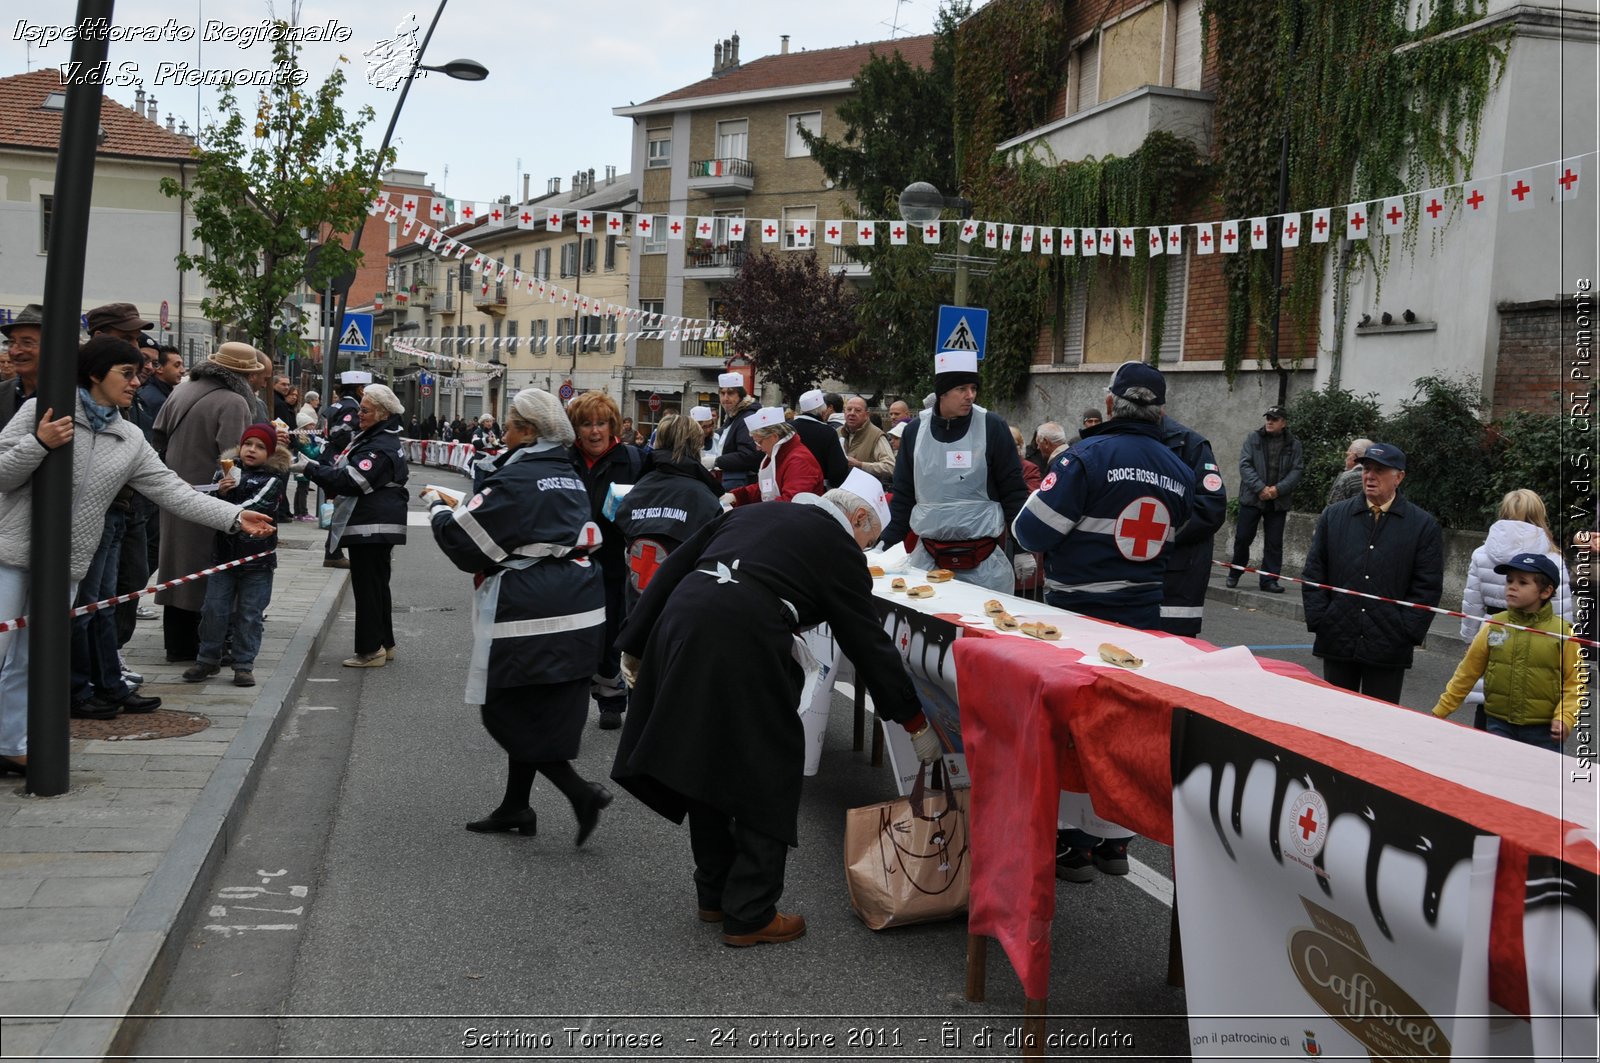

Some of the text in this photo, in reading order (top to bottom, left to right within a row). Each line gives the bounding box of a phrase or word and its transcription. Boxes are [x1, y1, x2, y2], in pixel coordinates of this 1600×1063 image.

[536, 477, 561, 491] CROCE
[1107, 467, 1186, 497] CROCE ROSSA ITALIAN
[631, 507, 687, 523] CROCE ROSSA ITALIANA
[1304, 945, 1439, 1056] Caffarel
[1193, 1032, 1290, 1047] con il patrocinio di
